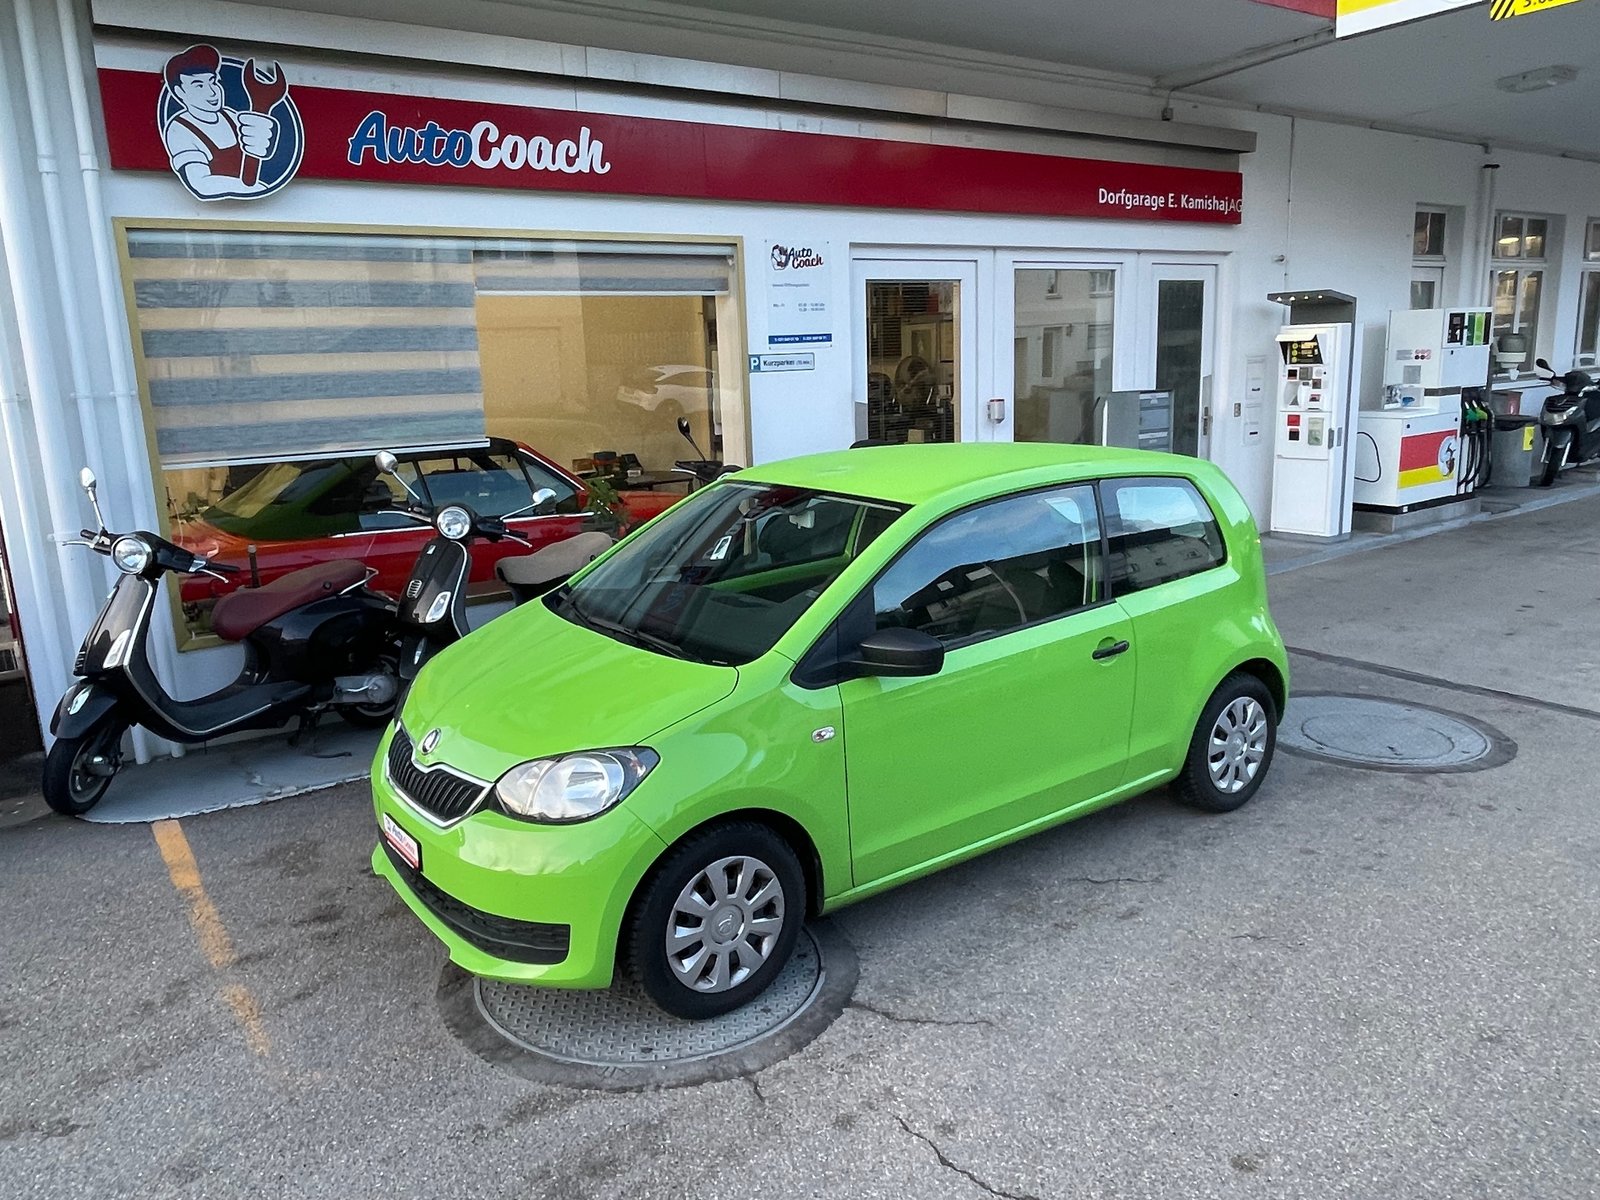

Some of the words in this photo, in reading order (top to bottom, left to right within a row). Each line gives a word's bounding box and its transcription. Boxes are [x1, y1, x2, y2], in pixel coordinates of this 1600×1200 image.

[1098, 188, 1165, 211] Dorfgarage
[1168, 193, 1178, 208] E.
[788, 247, 812, 259] Auto
[792, 254, 824, 270] Coach
[750, 357, 759, 370] P
